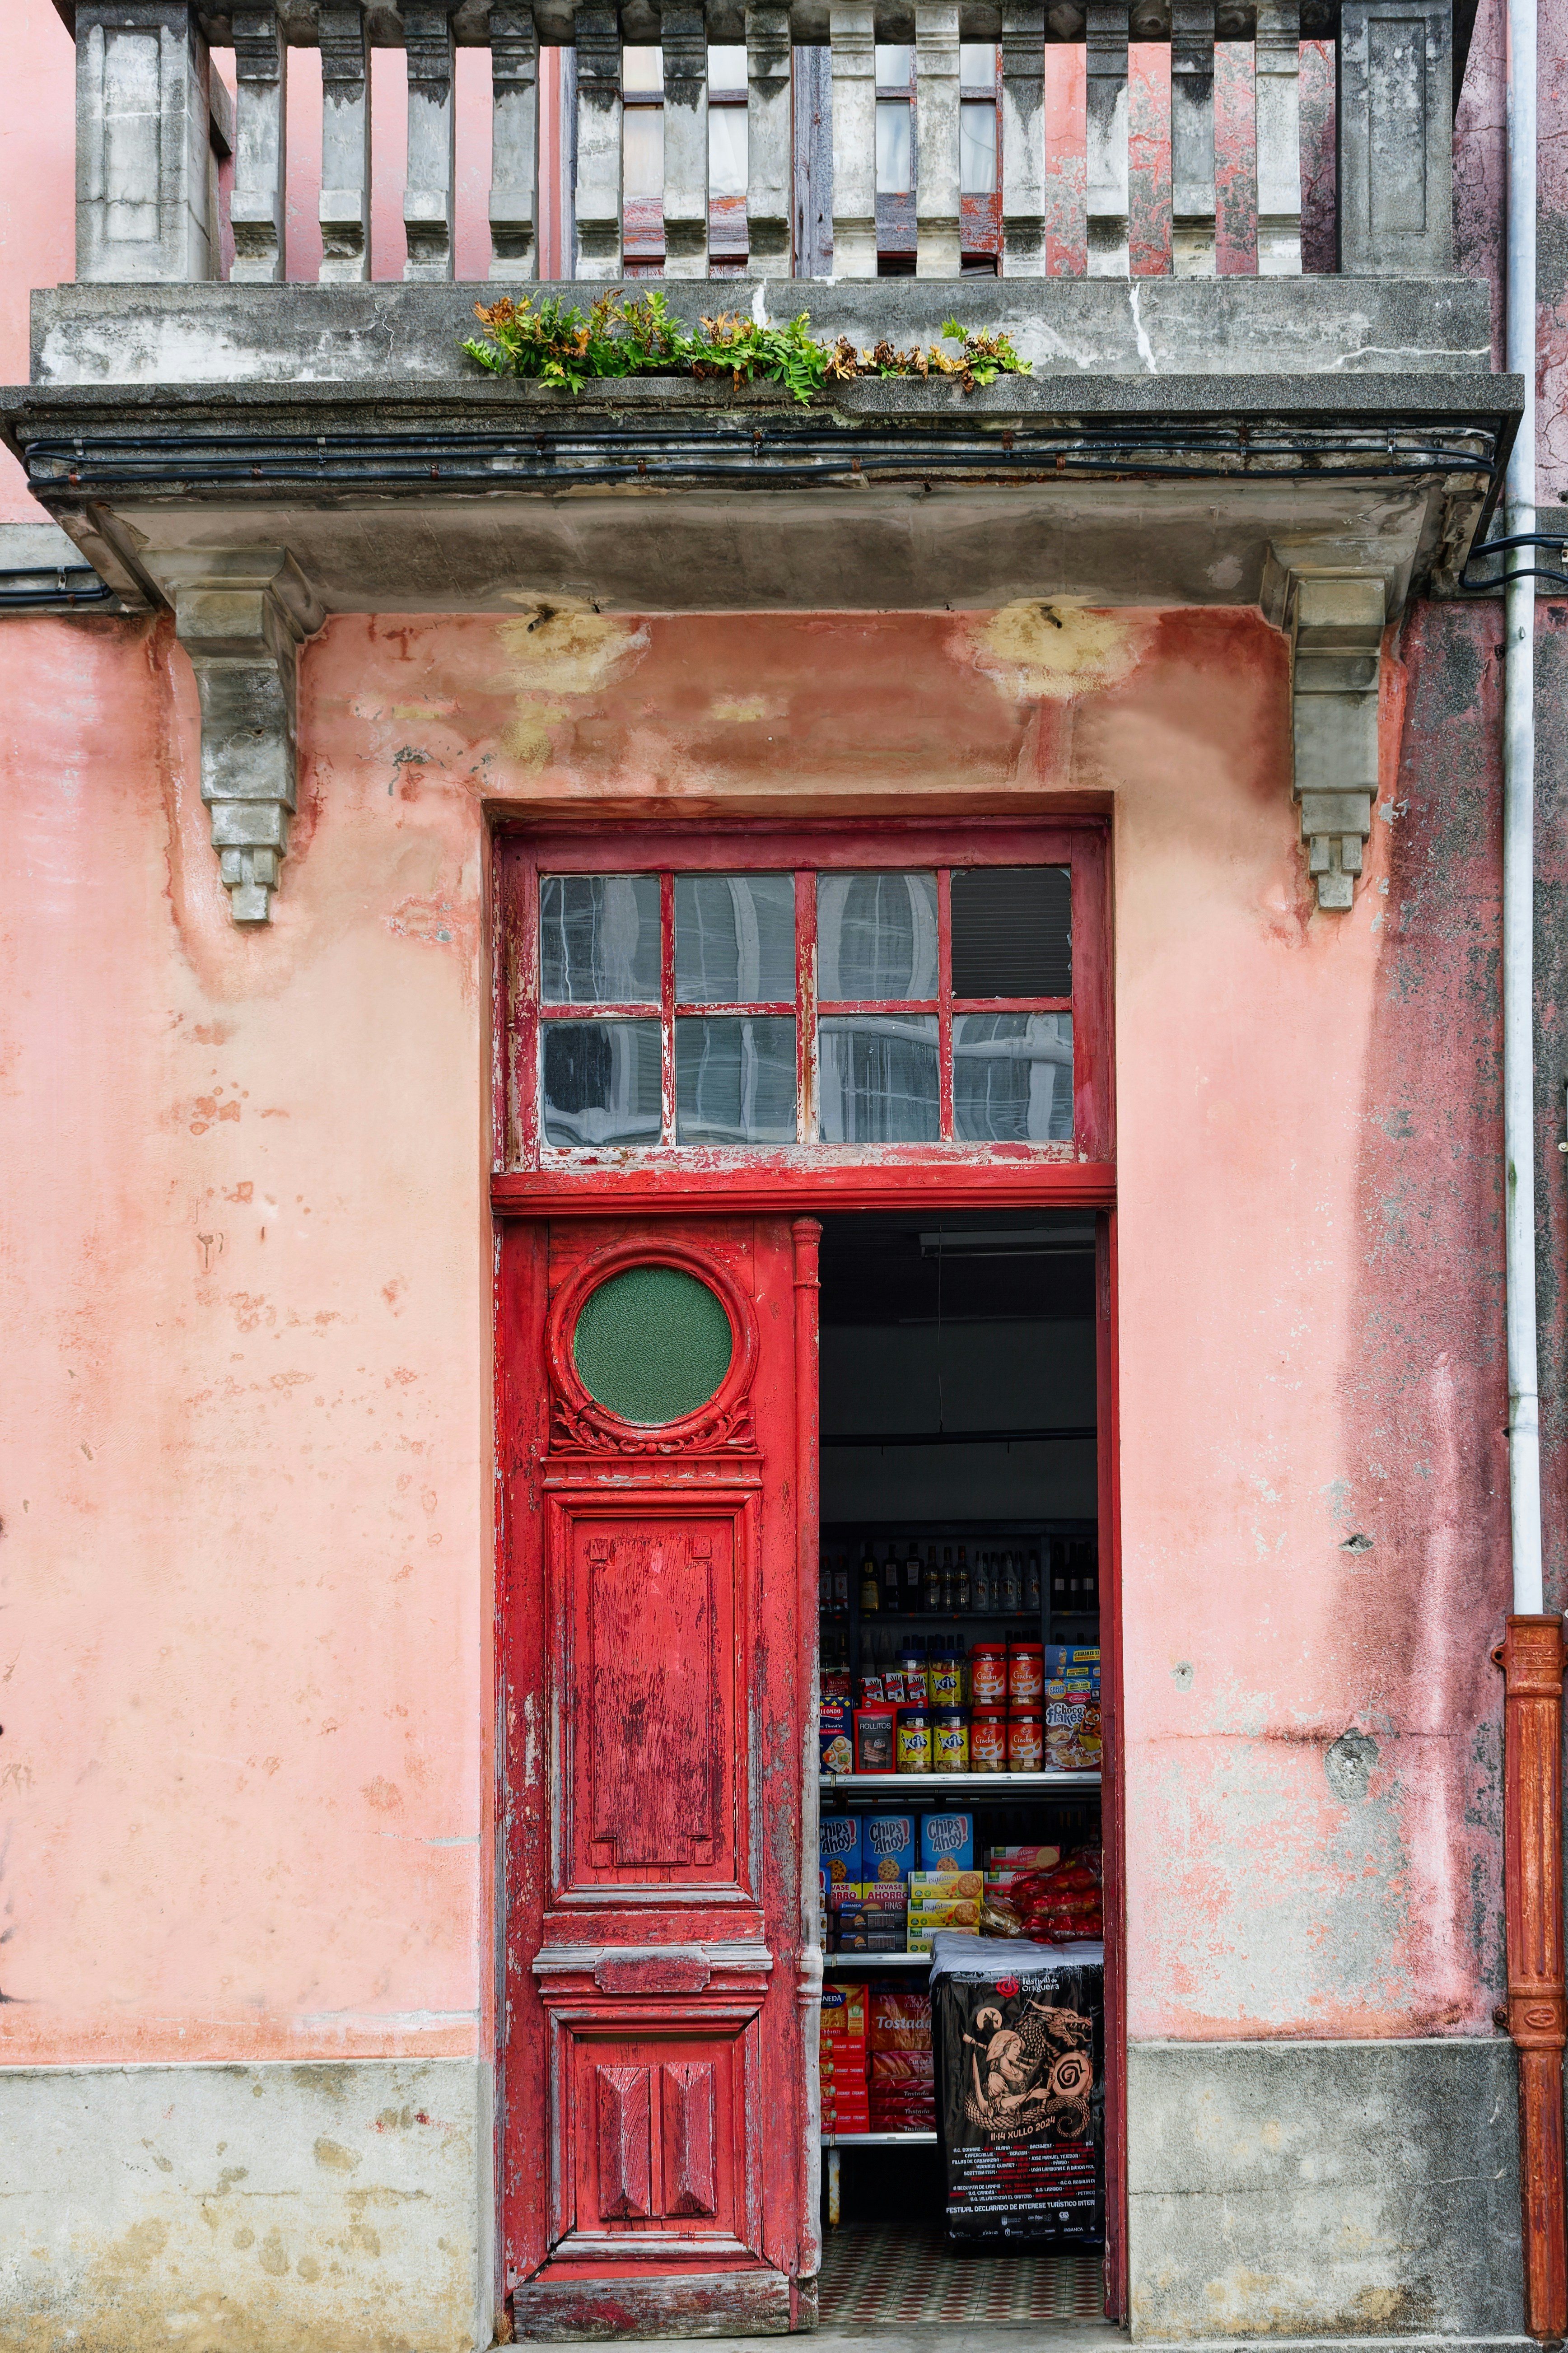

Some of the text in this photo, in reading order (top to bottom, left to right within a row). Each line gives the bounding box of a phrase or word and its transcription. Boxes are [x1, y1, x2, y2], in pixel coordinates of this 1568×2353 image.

[935, 1677, 956, 1691] Krit
[1054, 1704, 1082, 1714] Choco
[1047, 1708, 1083, 1726] flakes
[905, 1735, 927, 1750] Krit
[941, 1735, 963, 1749] Krit
[870, 1822, 901, 1842] Chips
[929, 1819, 960, 1839] Chips
[884, 1901, 902, 1910] FINAS
[1008, 2125, 1033, 2139] XULLO
[1035, 2116, 1055, 2132] 2024
[974, 2204, 1008, 2212] DECLARADO
[1018, 2202, 1046, 2210] INTERESE
[1047, 2199, 1077, 2208] TURÍSTICO
